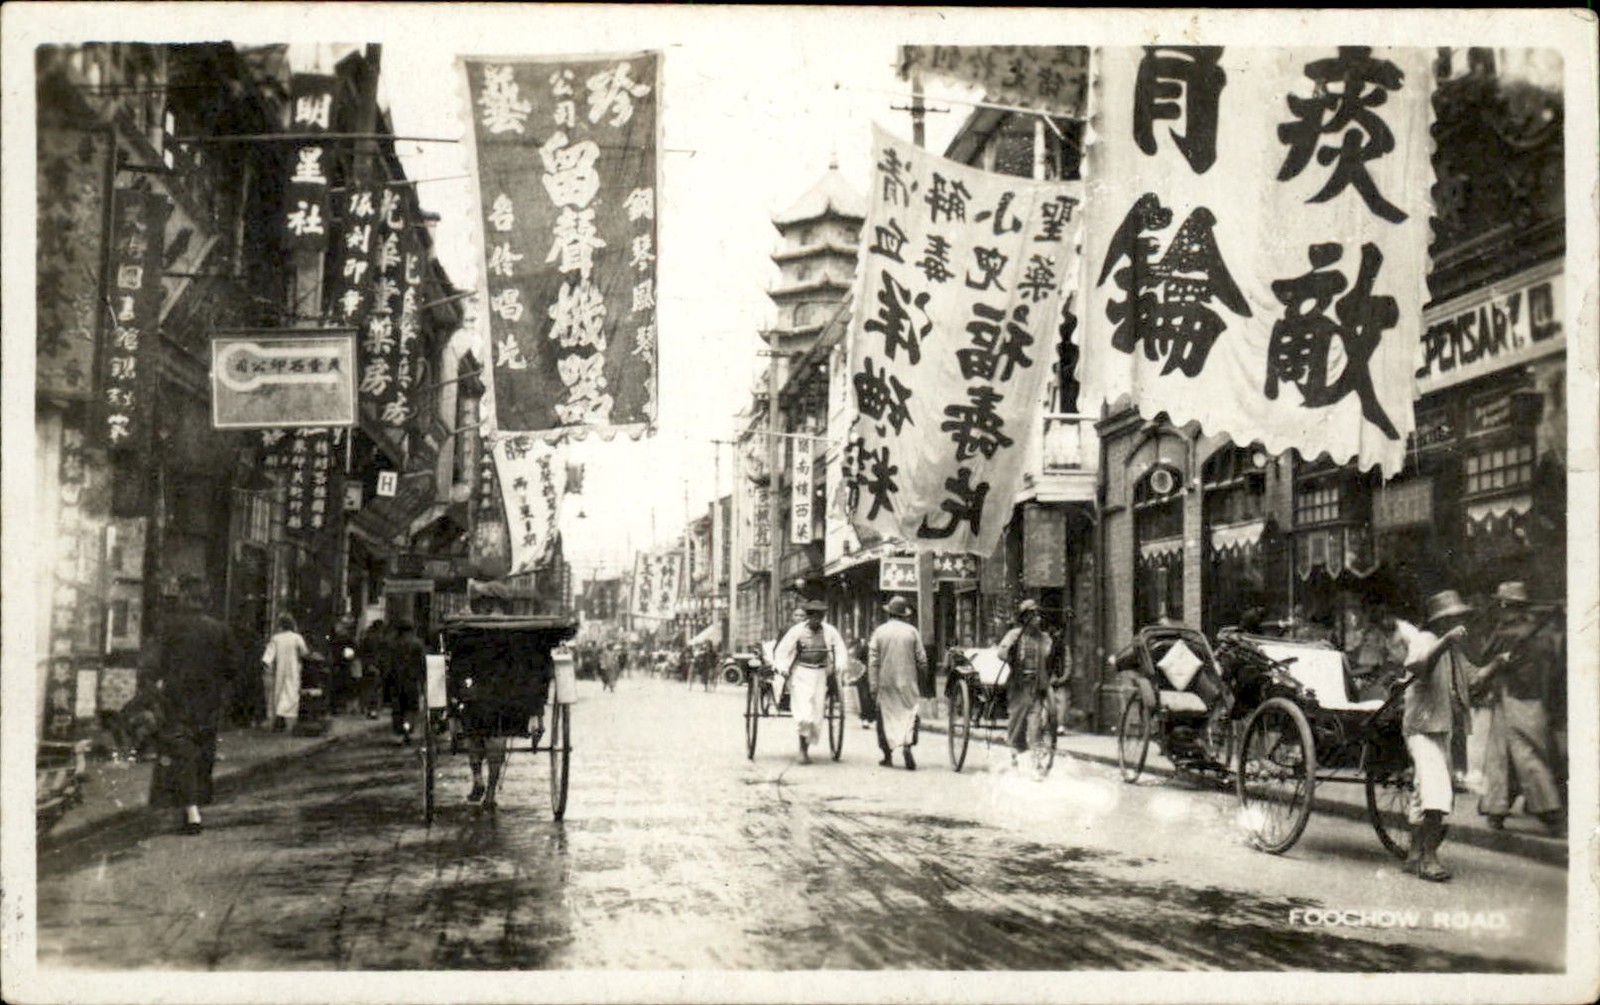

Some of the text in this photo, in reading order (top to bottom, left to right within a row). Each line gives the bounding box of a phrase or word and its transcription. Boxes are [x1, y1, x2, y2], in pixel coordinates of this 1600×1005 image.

[539, 131, 613, 425] 留聲機器
[1264, 45, 1409, 440] 痰敵
